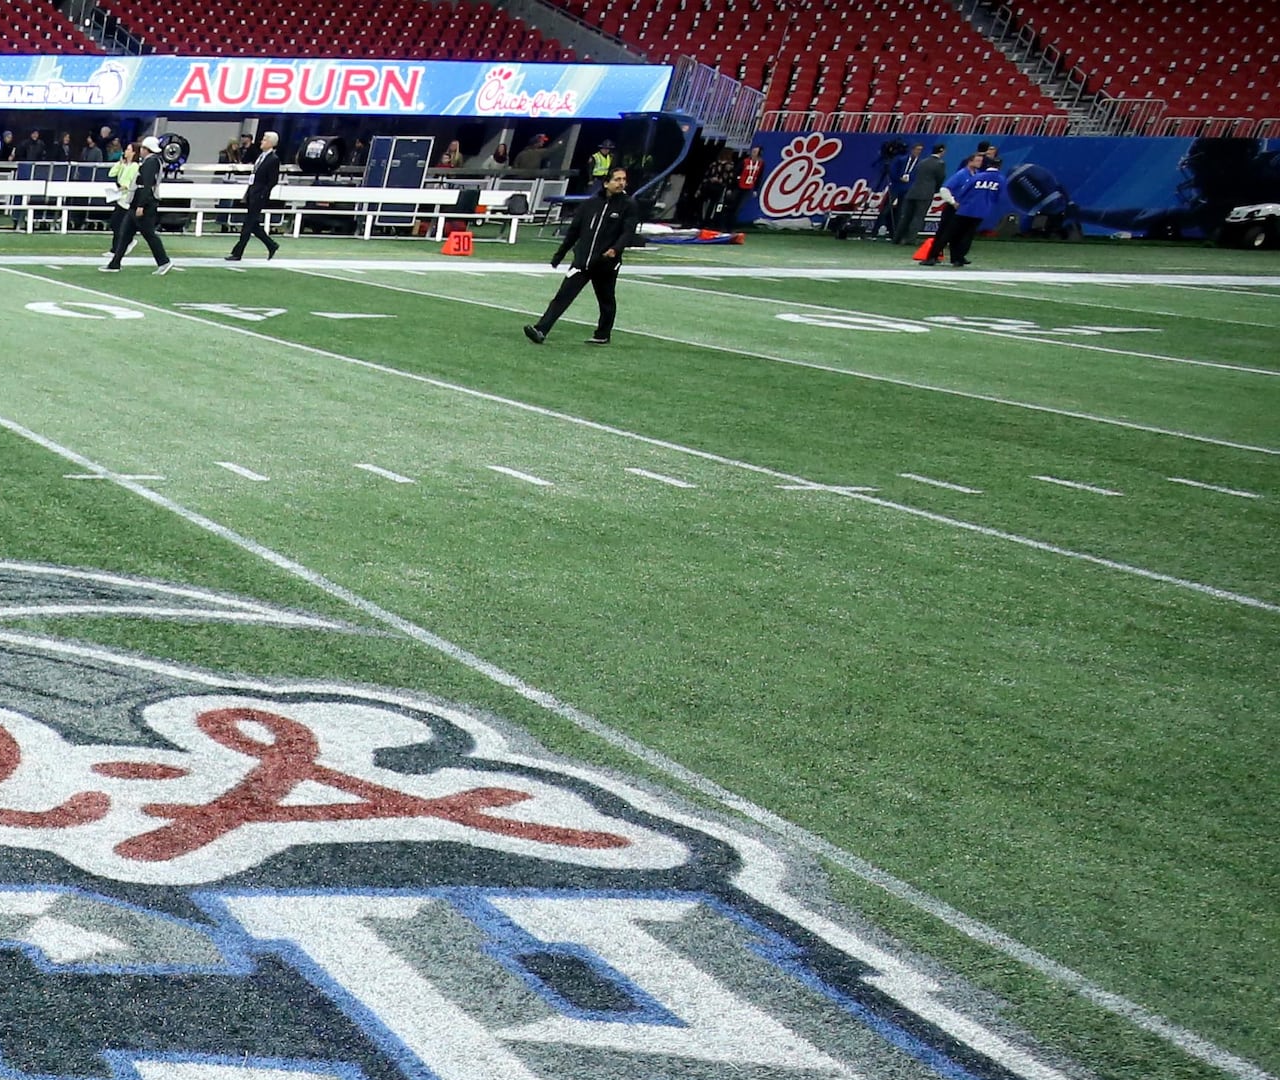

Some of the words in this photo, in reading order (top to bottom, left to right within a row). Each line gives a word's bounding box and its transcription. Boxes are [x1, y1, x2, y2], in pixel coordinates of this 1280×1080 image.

[46, 81, 104, 104] BOWL
[173, 65, 422, 108] AUBURN
[477, 69, 574, 115] Chick-fil-A
[453, 236, 470, 252] 30
